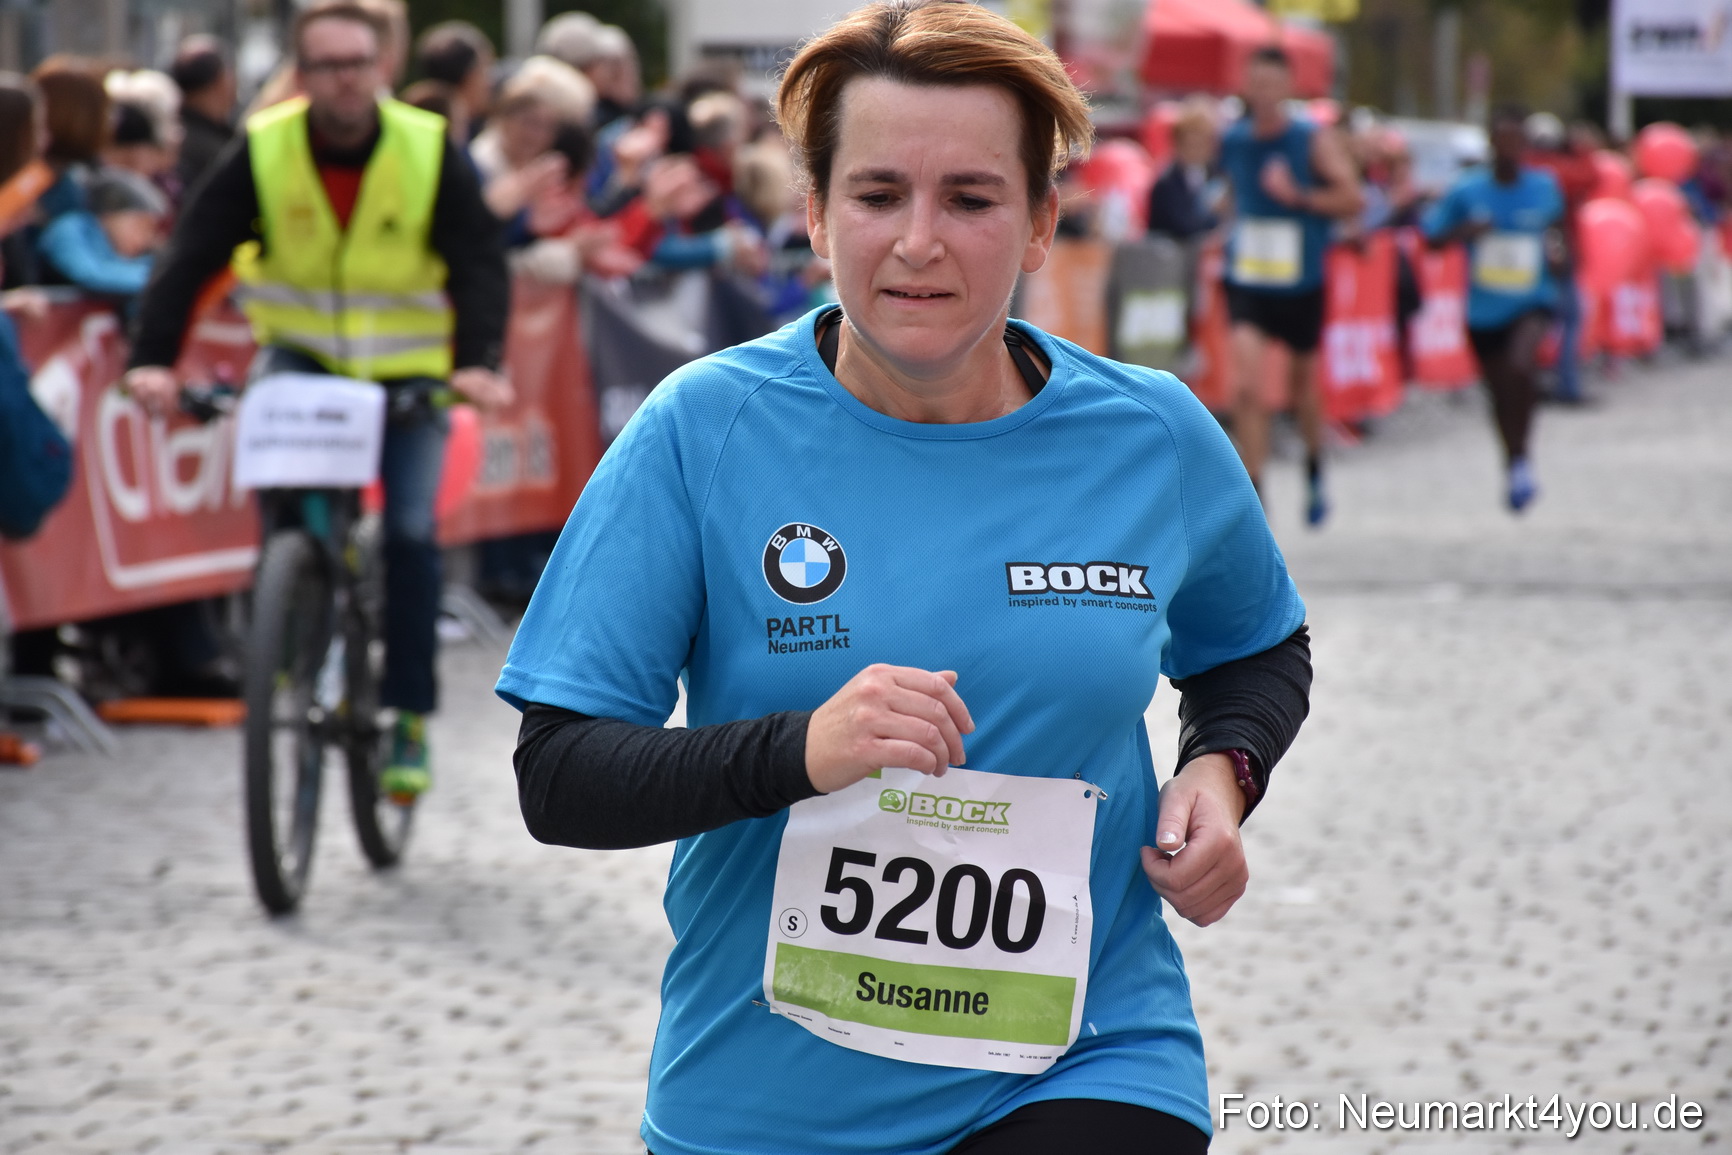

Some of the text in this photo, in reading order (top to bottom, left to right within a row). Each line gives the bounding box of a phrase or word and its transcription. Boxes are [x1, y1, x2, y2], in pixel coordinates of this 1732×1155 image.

[771, 525, 838, 553] BMW
[1005, 561, 1155, 599] BOCK
[1008, 595, 1158, 613] inspired by smart concepts
[766, 614, 850, 638] PARTL
[768, 635, 850, 655] Neumarkt
[908, 792, 1012, 826] BOCK
[906, 816, 1010, 835] inspired by smart concepts
[820, 846, 1047, 954] 5200
[787, 915, 799, 932] S
[856, 971, 990, 1016] Susanne
